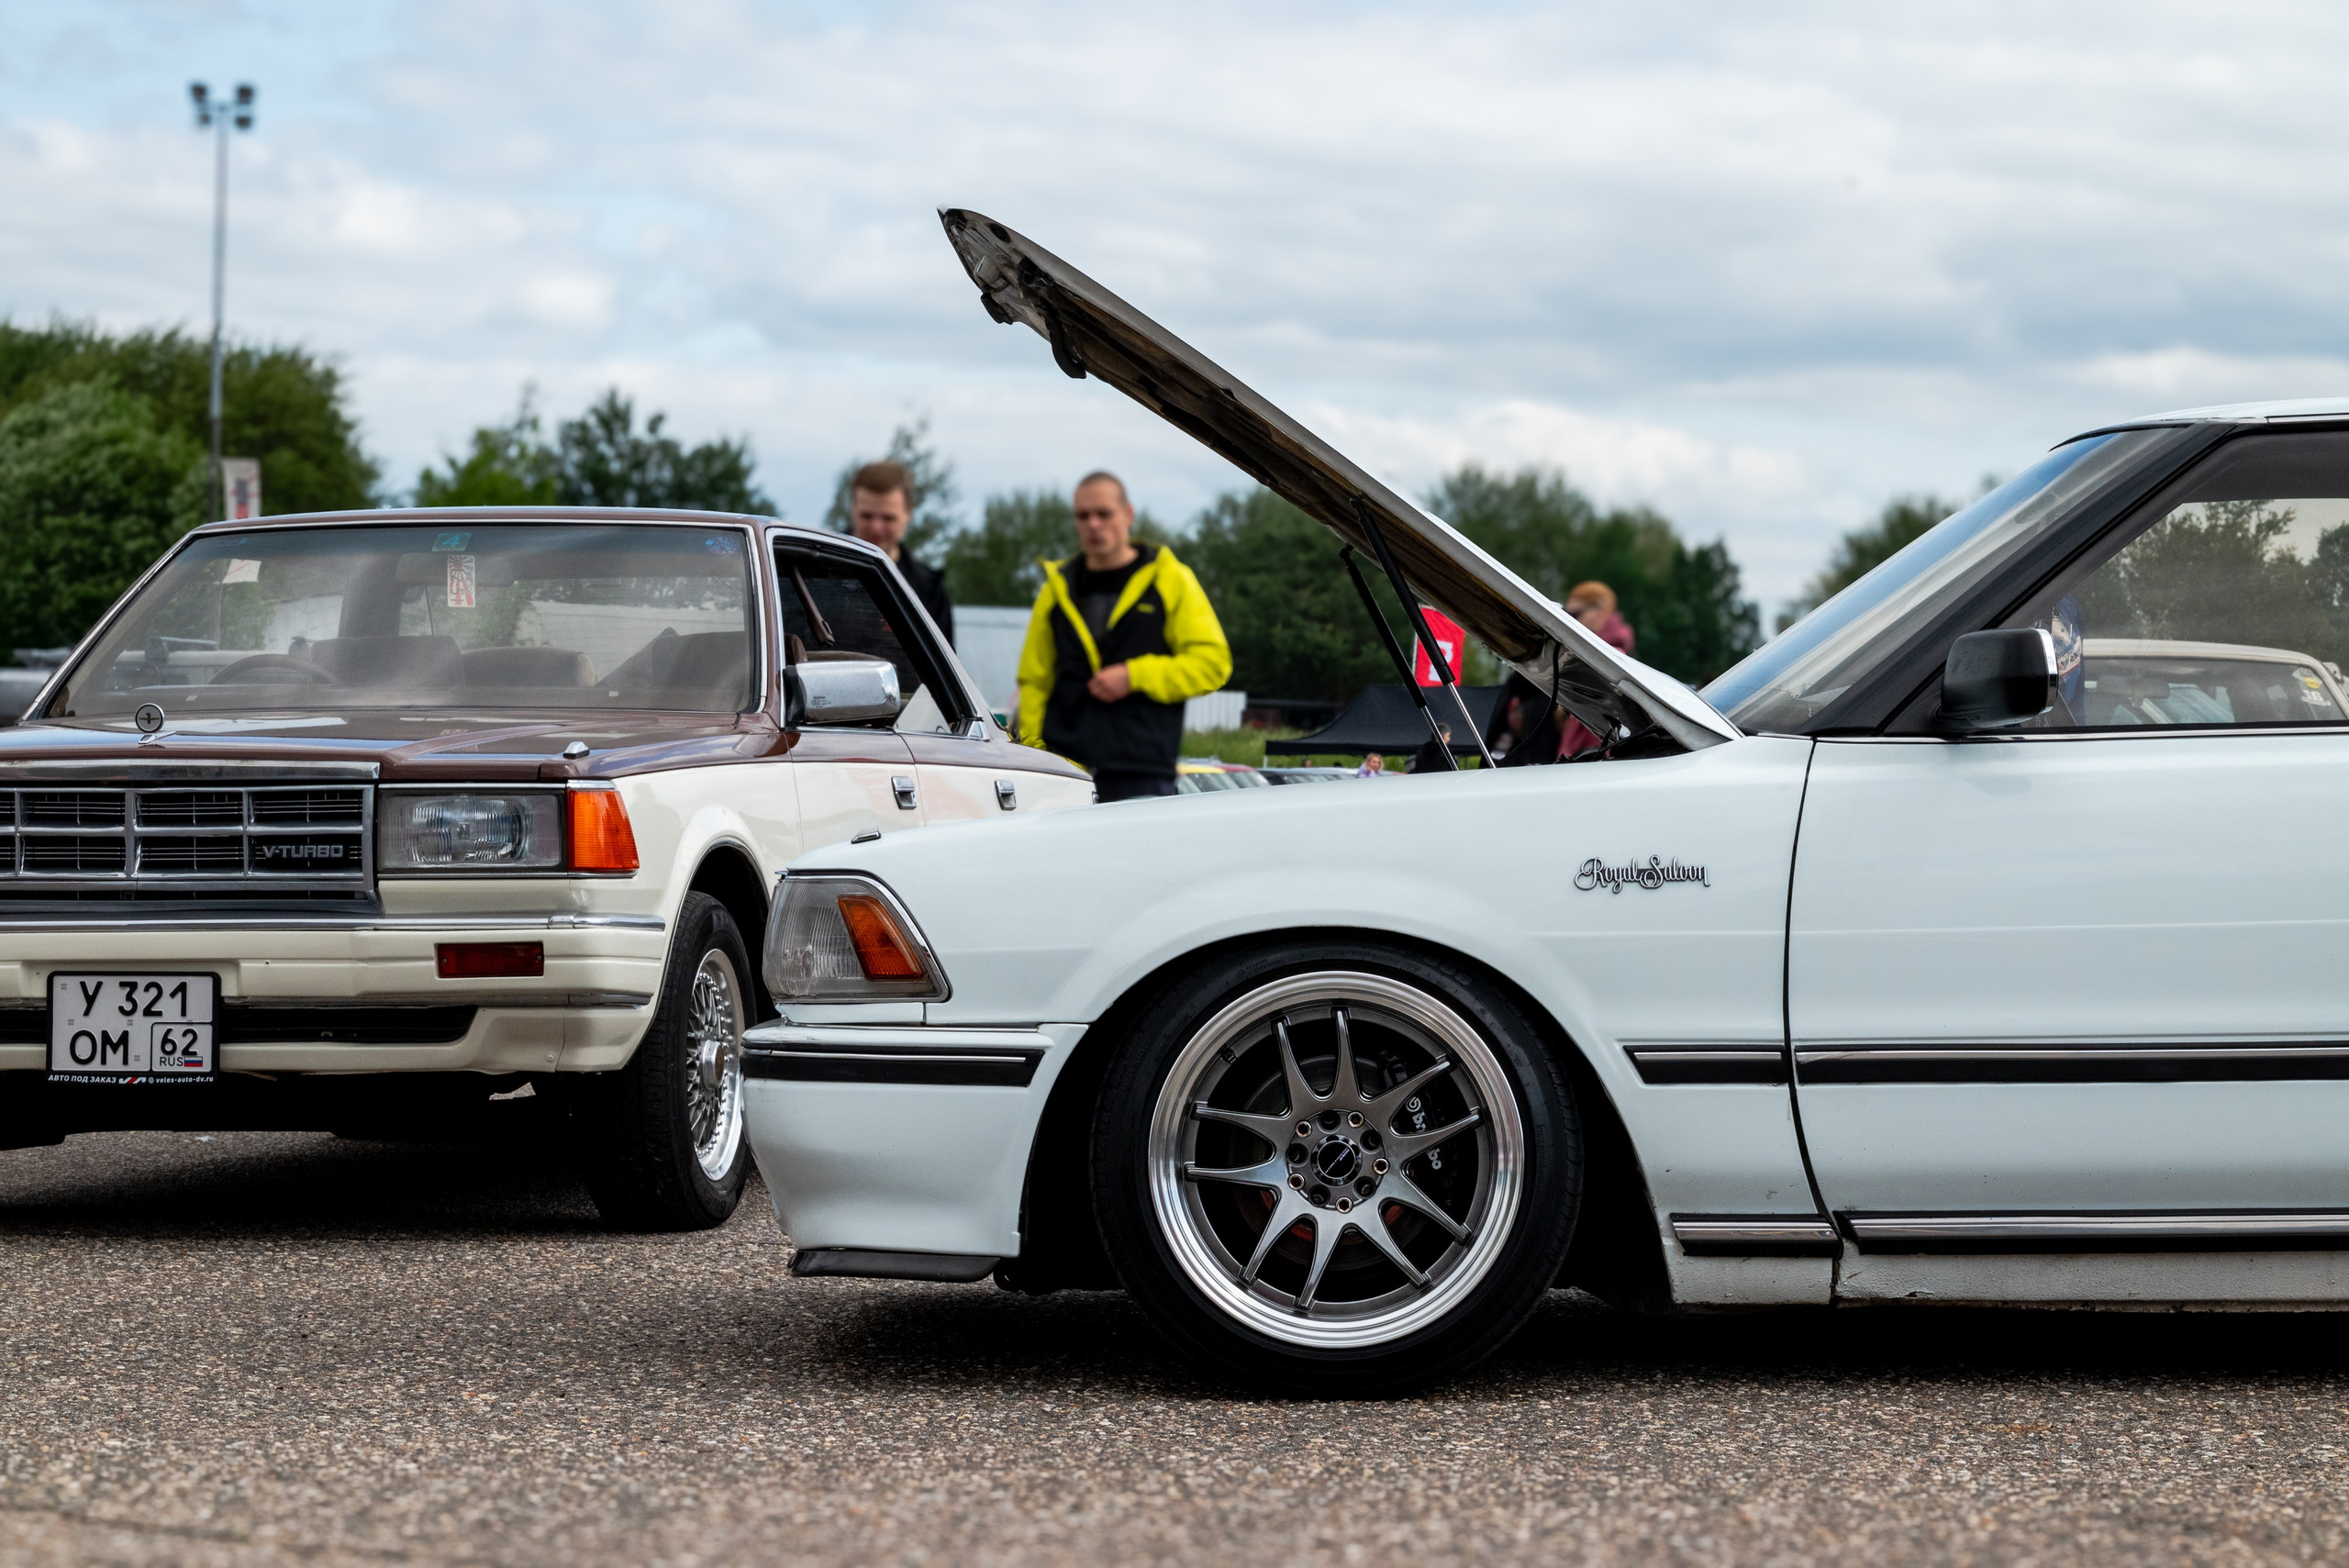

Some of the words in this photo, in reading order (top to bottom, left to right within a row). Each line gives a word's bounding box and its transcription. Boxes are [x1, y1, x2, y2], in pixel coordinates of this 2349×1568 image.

[262, 845, 343, 859] V-TURBO
[1574, 856, 1642, 895] Royal
[1640, 854, 1711, 890] Saloon
[117, 981, 187, 1018] 321
[160, 1028, 198, 1056] 62
[159, 1056, 184, 1067] RUS
[71, 1075, 89, 1084] ПОД
